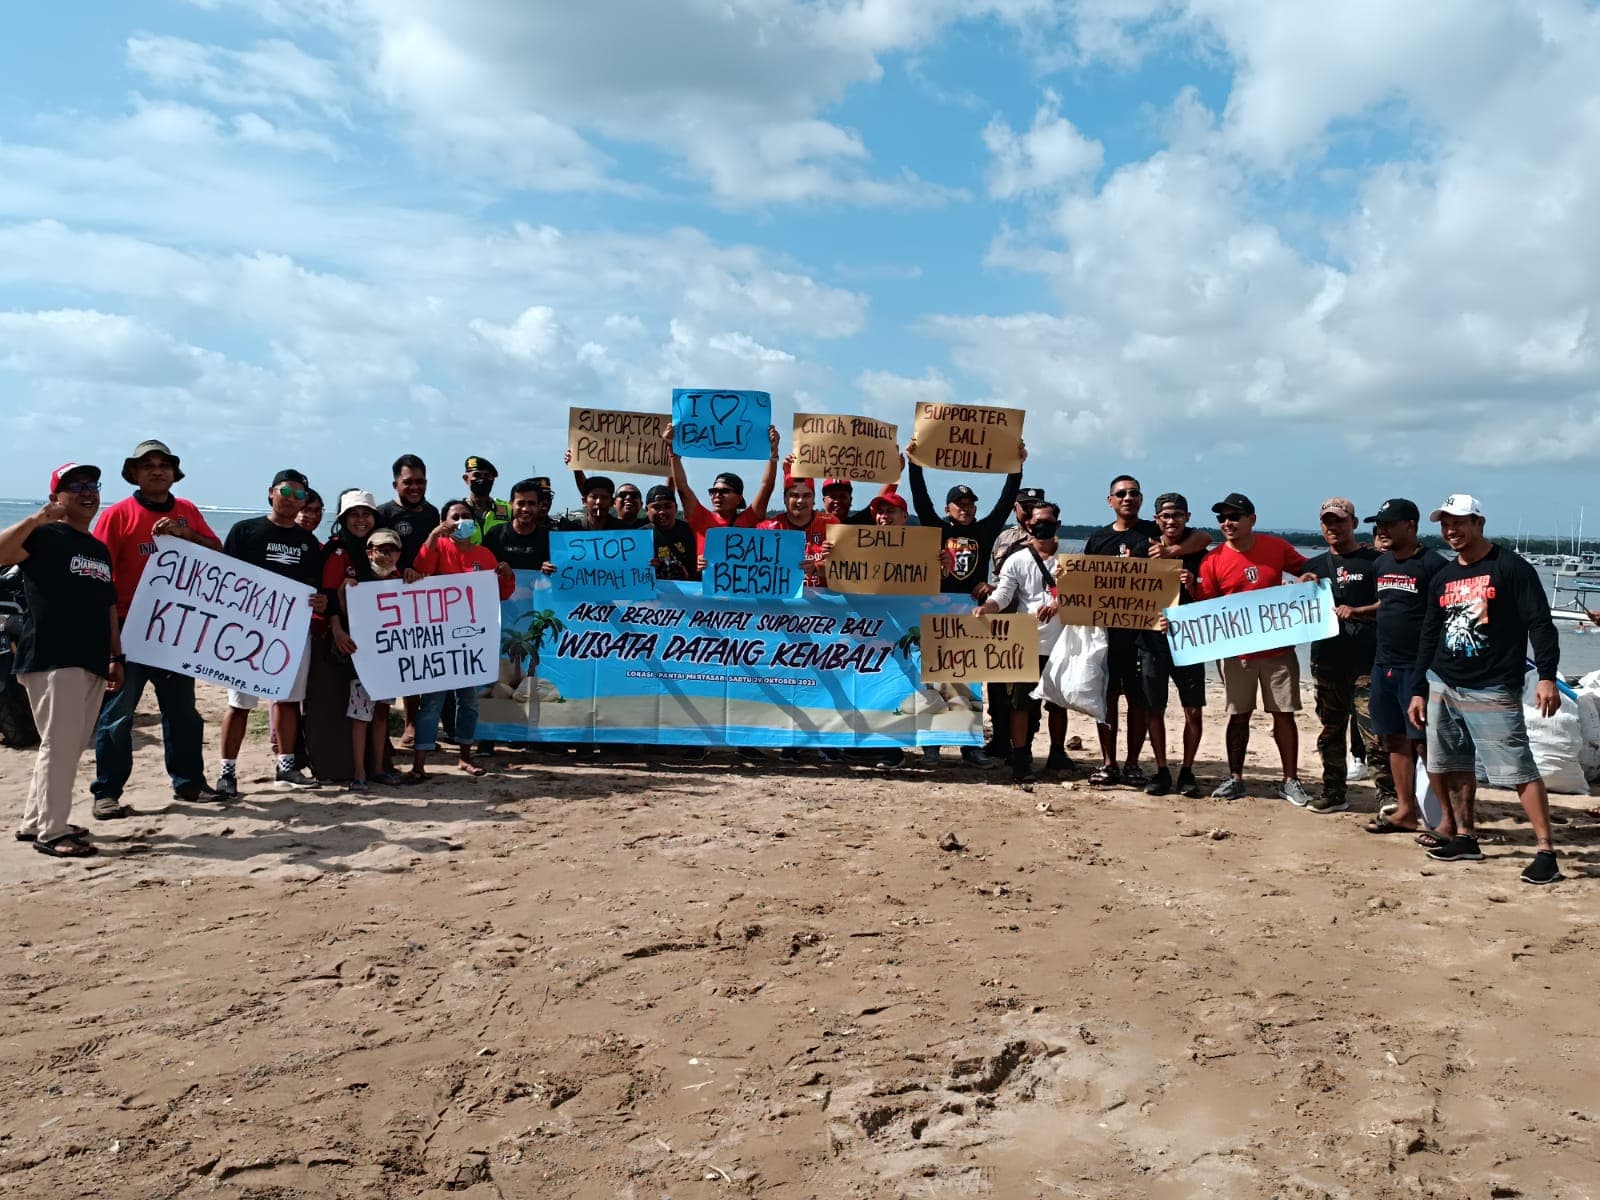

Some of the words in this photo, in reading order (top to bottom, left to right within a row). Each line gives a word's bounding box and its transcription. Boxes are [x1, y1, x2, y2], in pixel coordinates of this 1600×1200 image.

[688, 394, 702, 417] I
[924, 404, 1008, 426] SUPPORTER
[682, 423, 742, 447] BALI
[802, 416, 847, 435] anak
[568, 537, 636, 561] STOP
[559, 566, 627, 590] SAMPAH
[714, 562, 790, 595] BERSIH
[828, 560, 868, 581] AMAN
[1066, 560, 1148, 574] SELAMATKAN
[149, 550, 297, 631] SUKSESKAN
[1094, 575, 1126, 590] BUMI
[1130, 577, 1163, 592] KITA
[1059, 594, 1092, 608] DARI
[1098, 595, 1157, 612] SAMPAH
[567, 602, 617, 623] AKSI
[620, 606, 685, 627] BERSIH
[688, 610, 754, 631] PANTAI
[757, 613, 837, 636] SUPORTER
[840, 617, 884, 638] BALI
[1093, 610, 1155, 628] PLASTIK
[375, 623, 445, 654] SAMPAH
[556, 630, 659, 660] WISATA
[661, 634, 765, 667] DATANG
[770, 641, 893, 674] KEMBALI
[929, 645, 977, 678] jaga
[984, 643, 1024, 670] Bali
[659, 672, 685, 680] PANTAI
